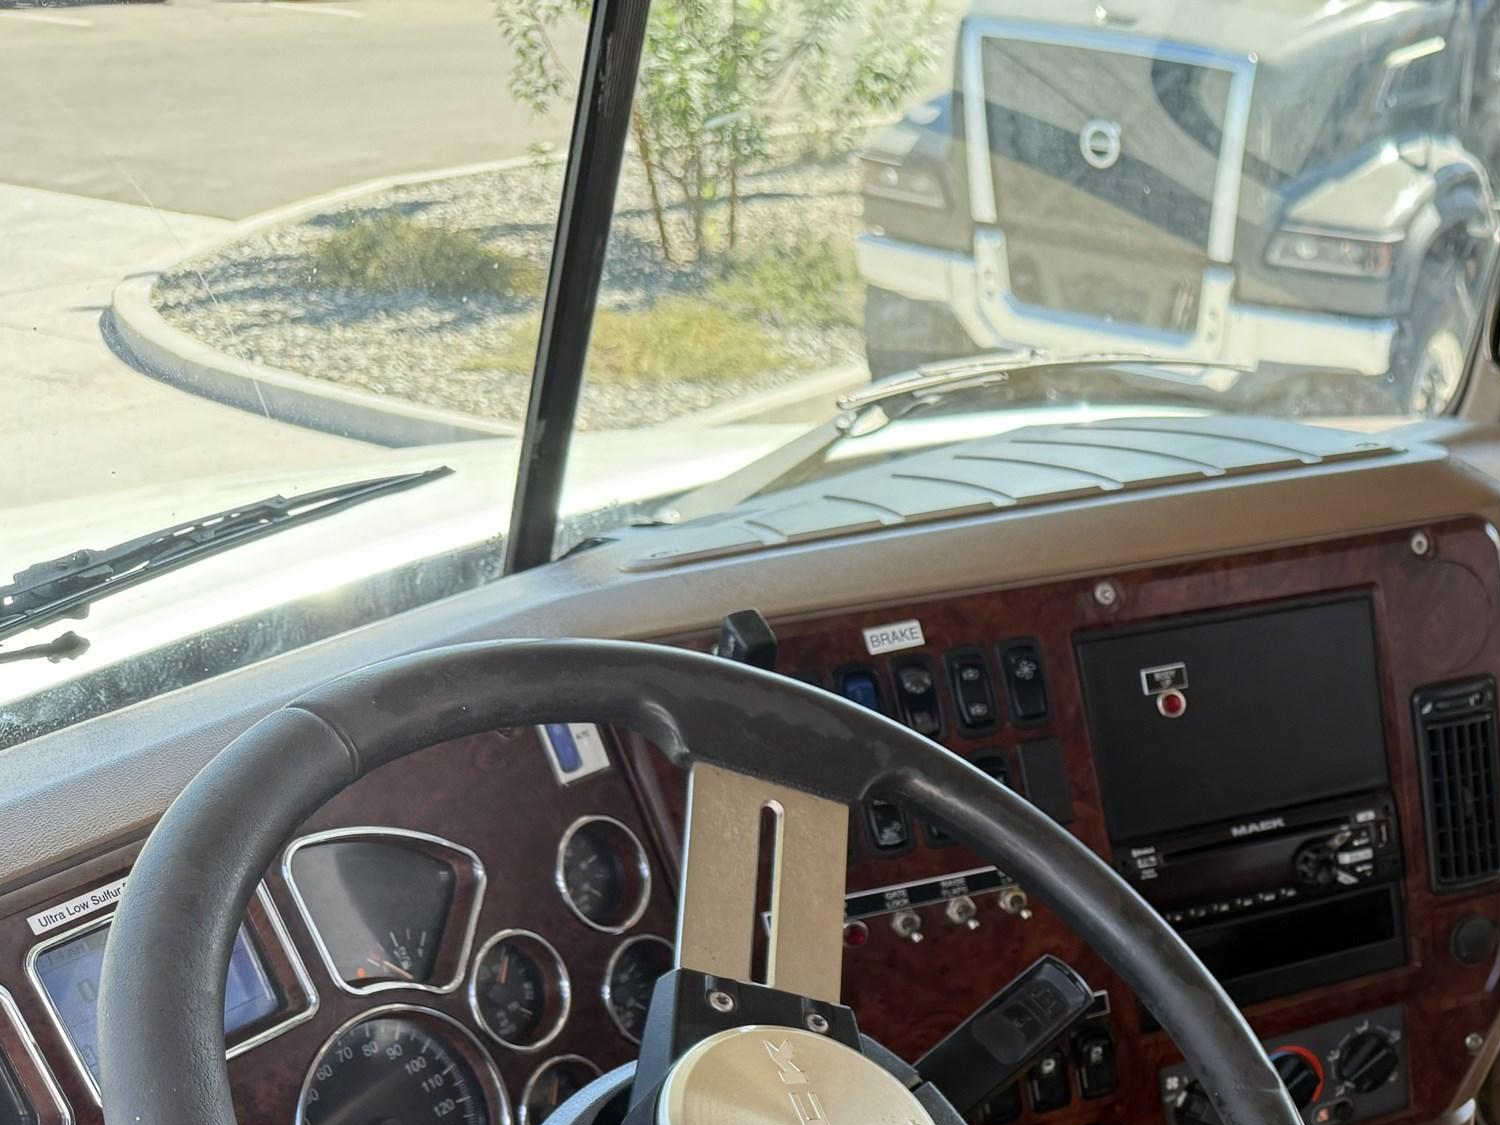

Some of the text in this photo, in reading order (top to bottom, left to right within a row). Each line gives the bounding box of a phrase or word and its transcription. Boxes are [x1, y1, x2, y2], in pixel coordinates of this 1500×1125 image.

[870, 627, 920, 648] BRAKE
[1231, 817, 1285, 837] MACK
[38, 909, 67, 928] Ultra
[67, 901, 91, 920] Low
[91, 888, 122, 907] Sulfur
[336, 1047, 353, 1063] 70
[362, 1041, 378, 1057] 80
[386, 1044, 403, 1060] 90
[316, 1065, 333, 1081] 60
[404, 1056, 426, 1075] 100
[422, 1074, 444, 1093] 110
[433, 1099, 455, 1118] 120
